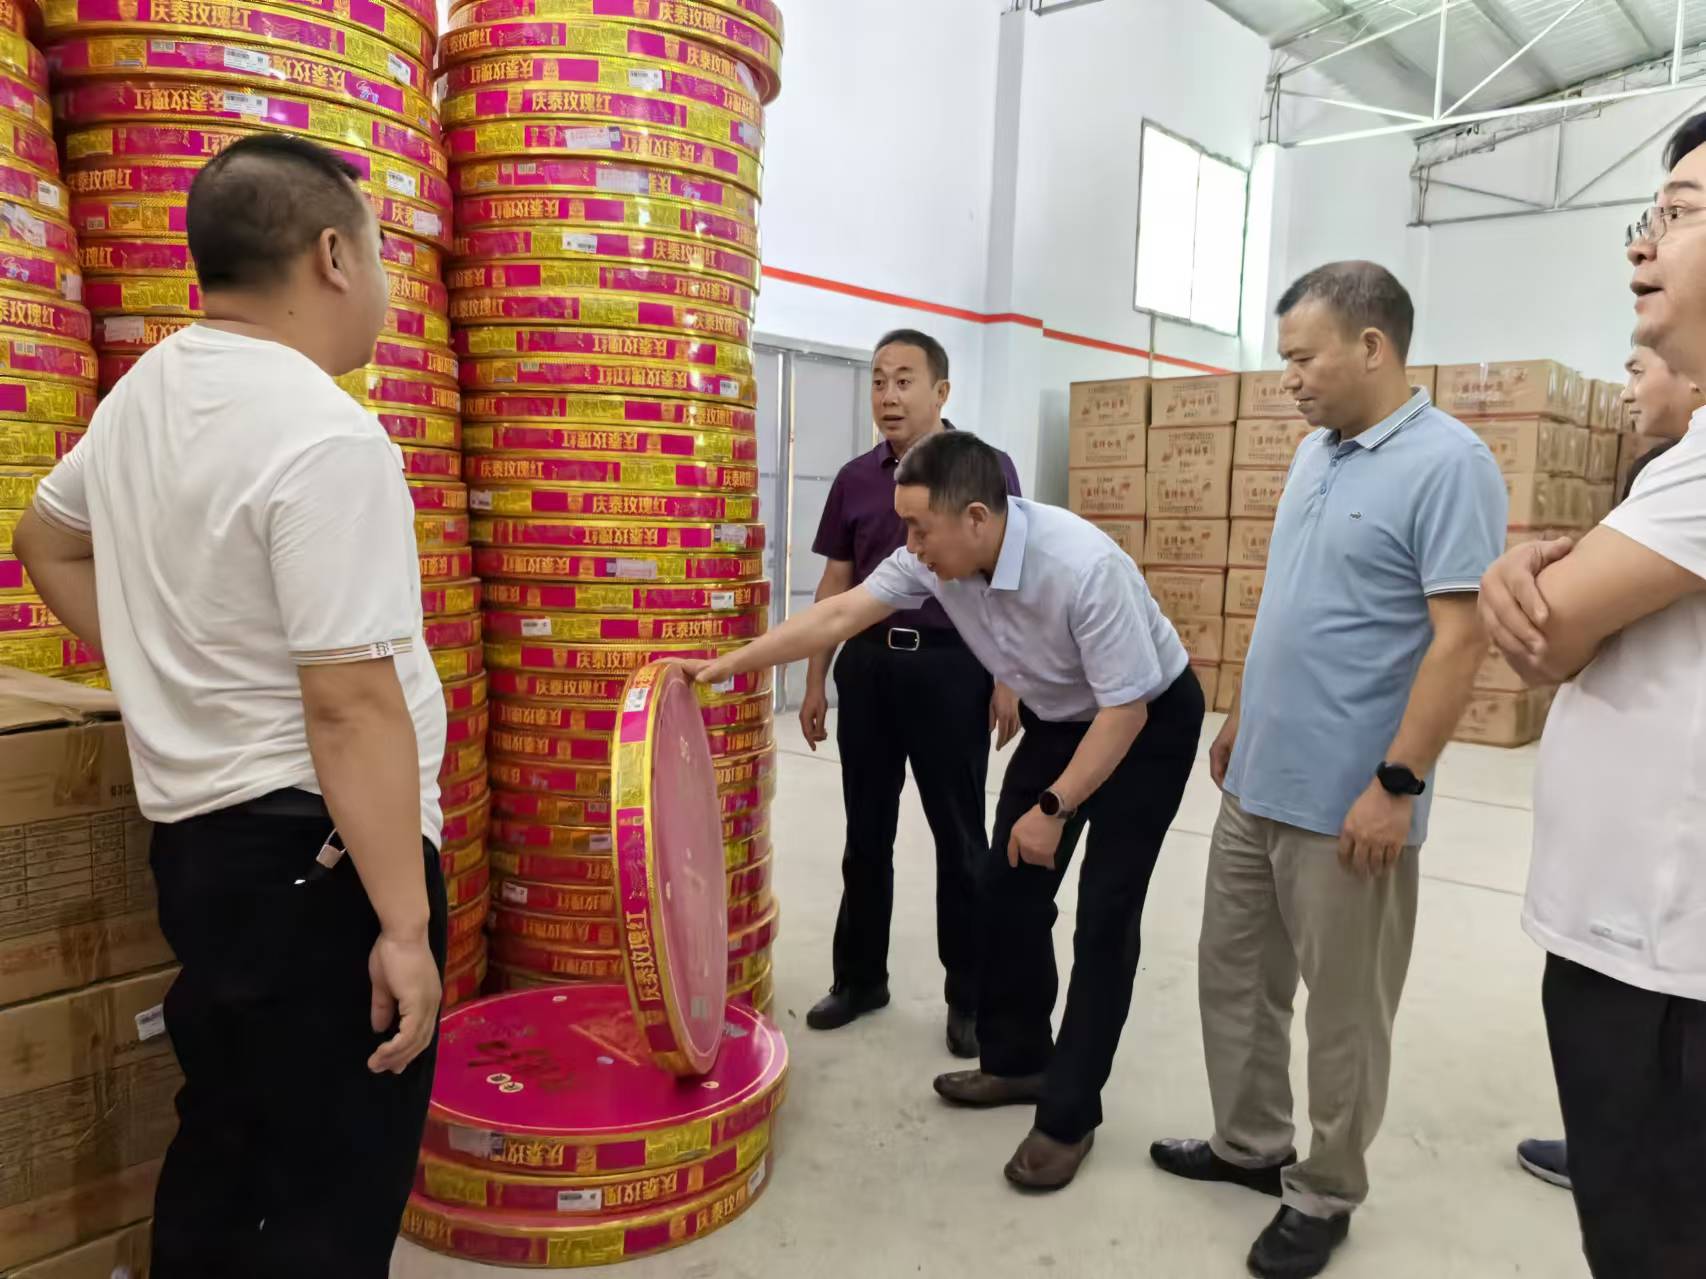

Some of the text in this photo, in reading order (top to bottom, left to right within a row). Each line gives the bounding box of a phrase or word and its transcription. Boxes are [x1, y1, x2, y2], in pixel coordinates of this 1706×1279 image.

[659, 2, 728, 37] 庆泰玫瑰红
[273, 55, 345, 92] 庆泰玫瑰
[532, 91, 613, 113] 庆泰玫瑰红
[593, 494, 668, 514] 庆泰玫瑰红
